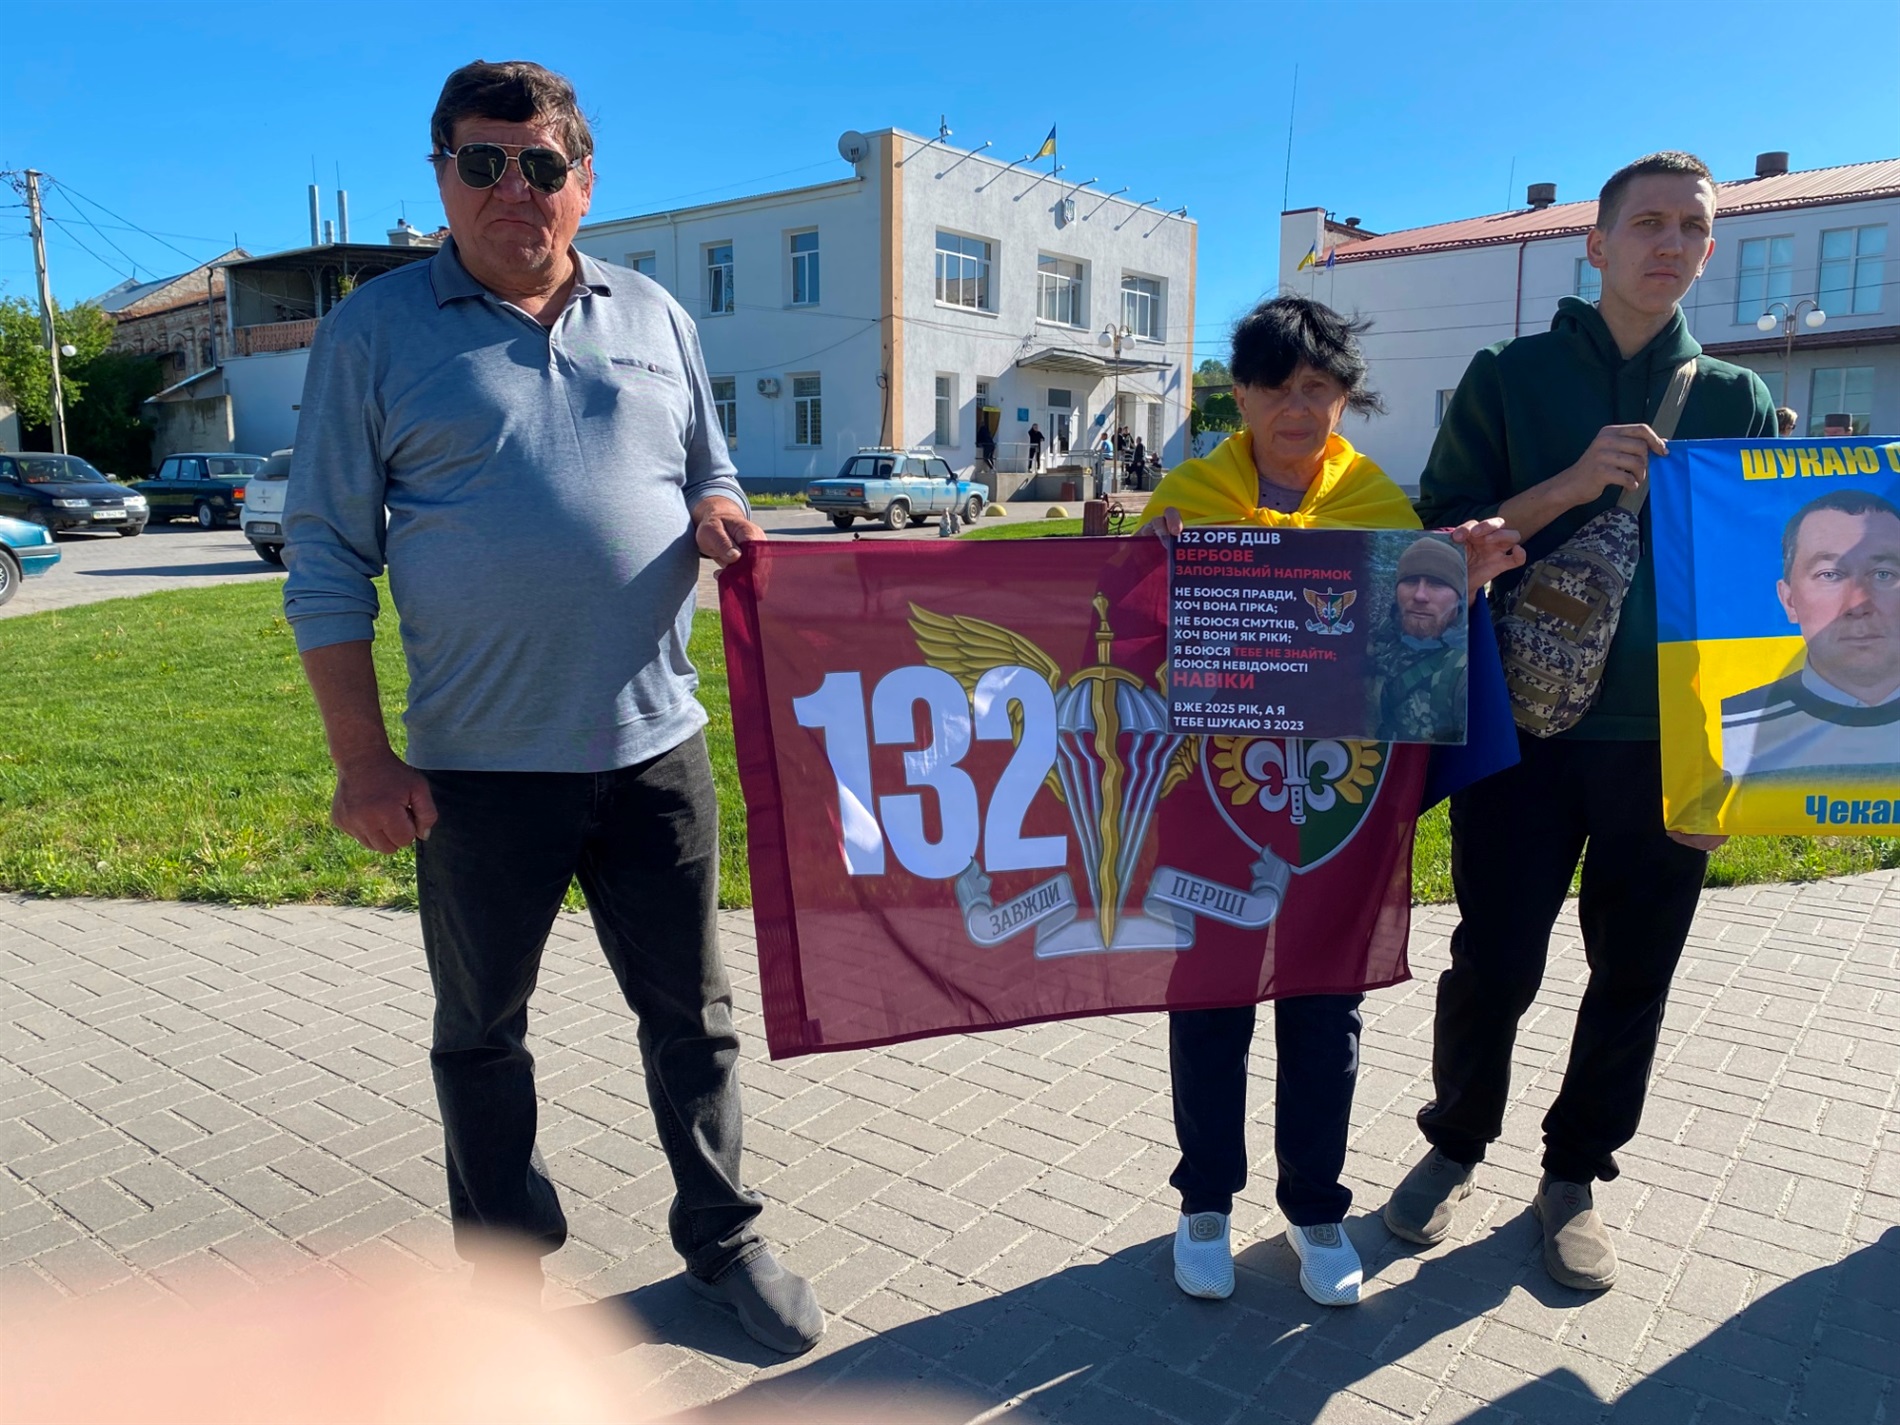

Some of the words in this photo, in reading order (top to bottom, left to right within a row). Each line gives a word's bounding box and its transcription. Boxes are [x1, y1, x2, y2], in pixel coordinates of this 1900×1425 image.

[1741, 446, 1880, 480] ШУКАЮ
[1177, 531, 1200, 543] 132
[1204, 531, 1237, 544] ОРБ
[1240, 532, 1281, 546] ДШВ
[1175, 548, 1254, 562] ВЕРБОВЕ
[1175, 564, 1271, 578] ЗАПОРІЗЬКИЙ
[1274, 568, 1352, 580] НАПРЯМОК
[1175, 587, 1191, 597] НЕ
[1193, 587, 1240, 599] БОЮСЯ
[1242, 589, 1297, 601] ПРАВДИ,
[1174, 600, 1200, 610] ХОЧ
[1203, 601, 1238, 612] ВОНА
[1239, 602, 1279, 615] ГІРКА;
[1174, 616, 1191, 626] НЕ
[1193, 617, 1240, 628] БОЮСЯ
[1242, 618, 1299, 631] СМУТКІВ,
[1174, 630, 1200, 640] ХОЧ
[1203, 631, 1238, 641] ВОНИ
[1240, 631, 1257, 642] ЯК
[1259, 632, 1292, 644] РІКИ;
[1174, 645, 1182, 655] Я
[1184, 645, 1231, 657] БОЮСЯ
[1233, 647, 1262, 658] ТЕБЕ
[1265, 648, 1282, 658] НЕ
[1284, 647, 1337, 662] ЗНАЙТИ;
[1174, 659, 1220, 670] БОЮСЯ
[1222, 660, 1309, 673] НЕВІДОМОСТІ
[1173, 671, 1255, 689] НАВІКИ
[1174, 702, 1203, 713] ВЖЕ
[1205, 702, 1236, 714] 2025
[1238, 704, 1263, 716] РІК,
[1265, 705, 1275, 715] А
[1277, 706, 1286, 716] Я
[1174, 716, 1204, 728] ТЕБЕ
[1207, 718, 1261, 729] ШУКАЮ
[1274, 720, 1305, 731] 2023
[793, 665, 1067, 879] 132
[988, 880, 1062, 937] ЗАВЖДИ
[1171, 875, 1248, 918] ПЕРШІ
